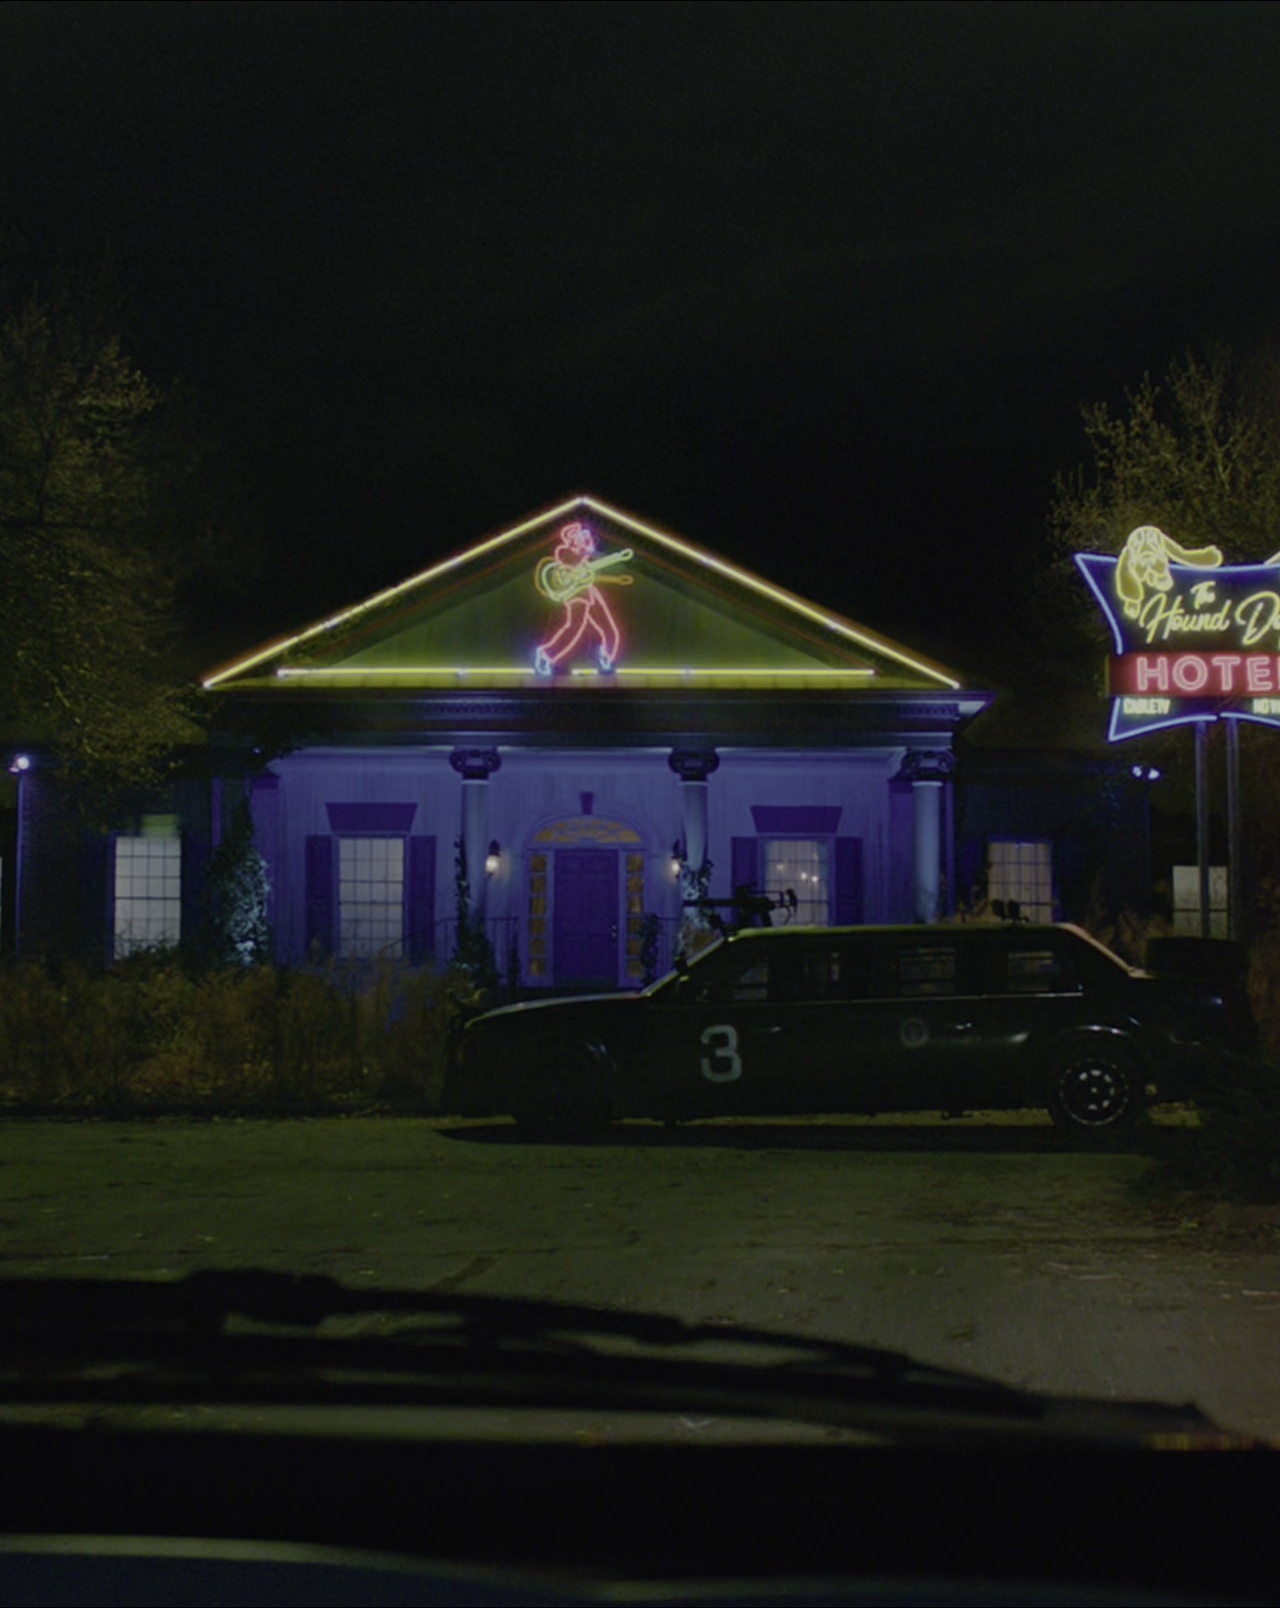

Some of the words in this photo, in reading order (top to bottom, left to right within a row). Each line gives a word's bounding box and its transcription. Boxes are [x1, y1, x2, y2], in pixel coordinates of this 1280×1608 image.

[1139, 592, 1231, 644] Hound
[1190, 581, 1216, 609] The
[700, 1024, 743, 1083] 3
